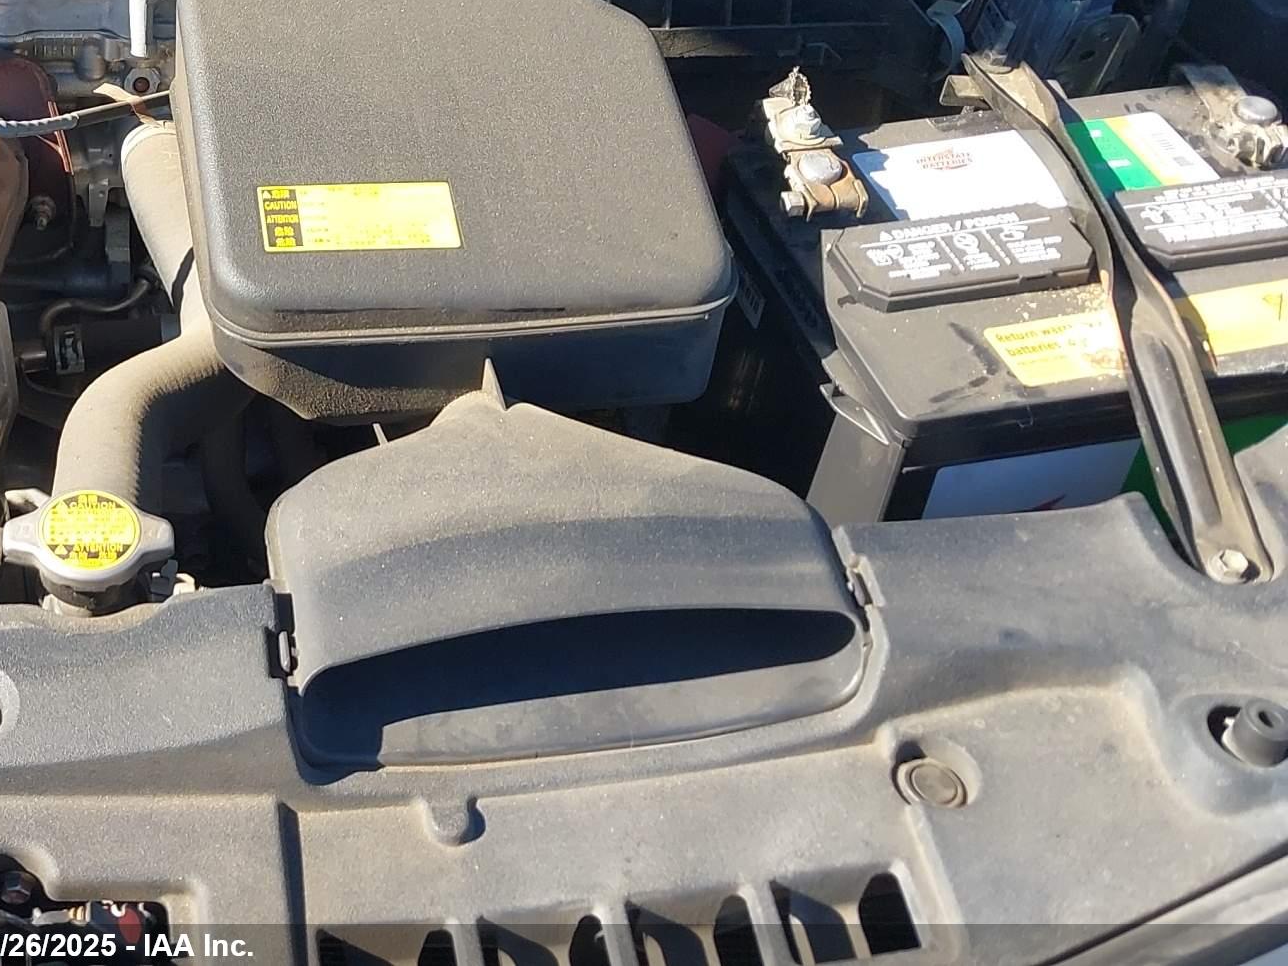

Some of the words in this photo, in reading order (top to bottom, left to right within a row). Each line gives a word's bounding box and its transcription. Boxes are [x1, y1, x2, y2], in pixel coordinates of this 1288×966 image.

[264, 200, 297, 211] CAUTION
[266, 214, 299, 224] ATTENTION
[891, 222, 954, 241] DANGER
[995, 330, 1039, 343] Return
[1005, 341, 1062, 357] batteries
[69, 501, 116, 510] CAUTION
[72, 542, 123, 552] ATTENTION
